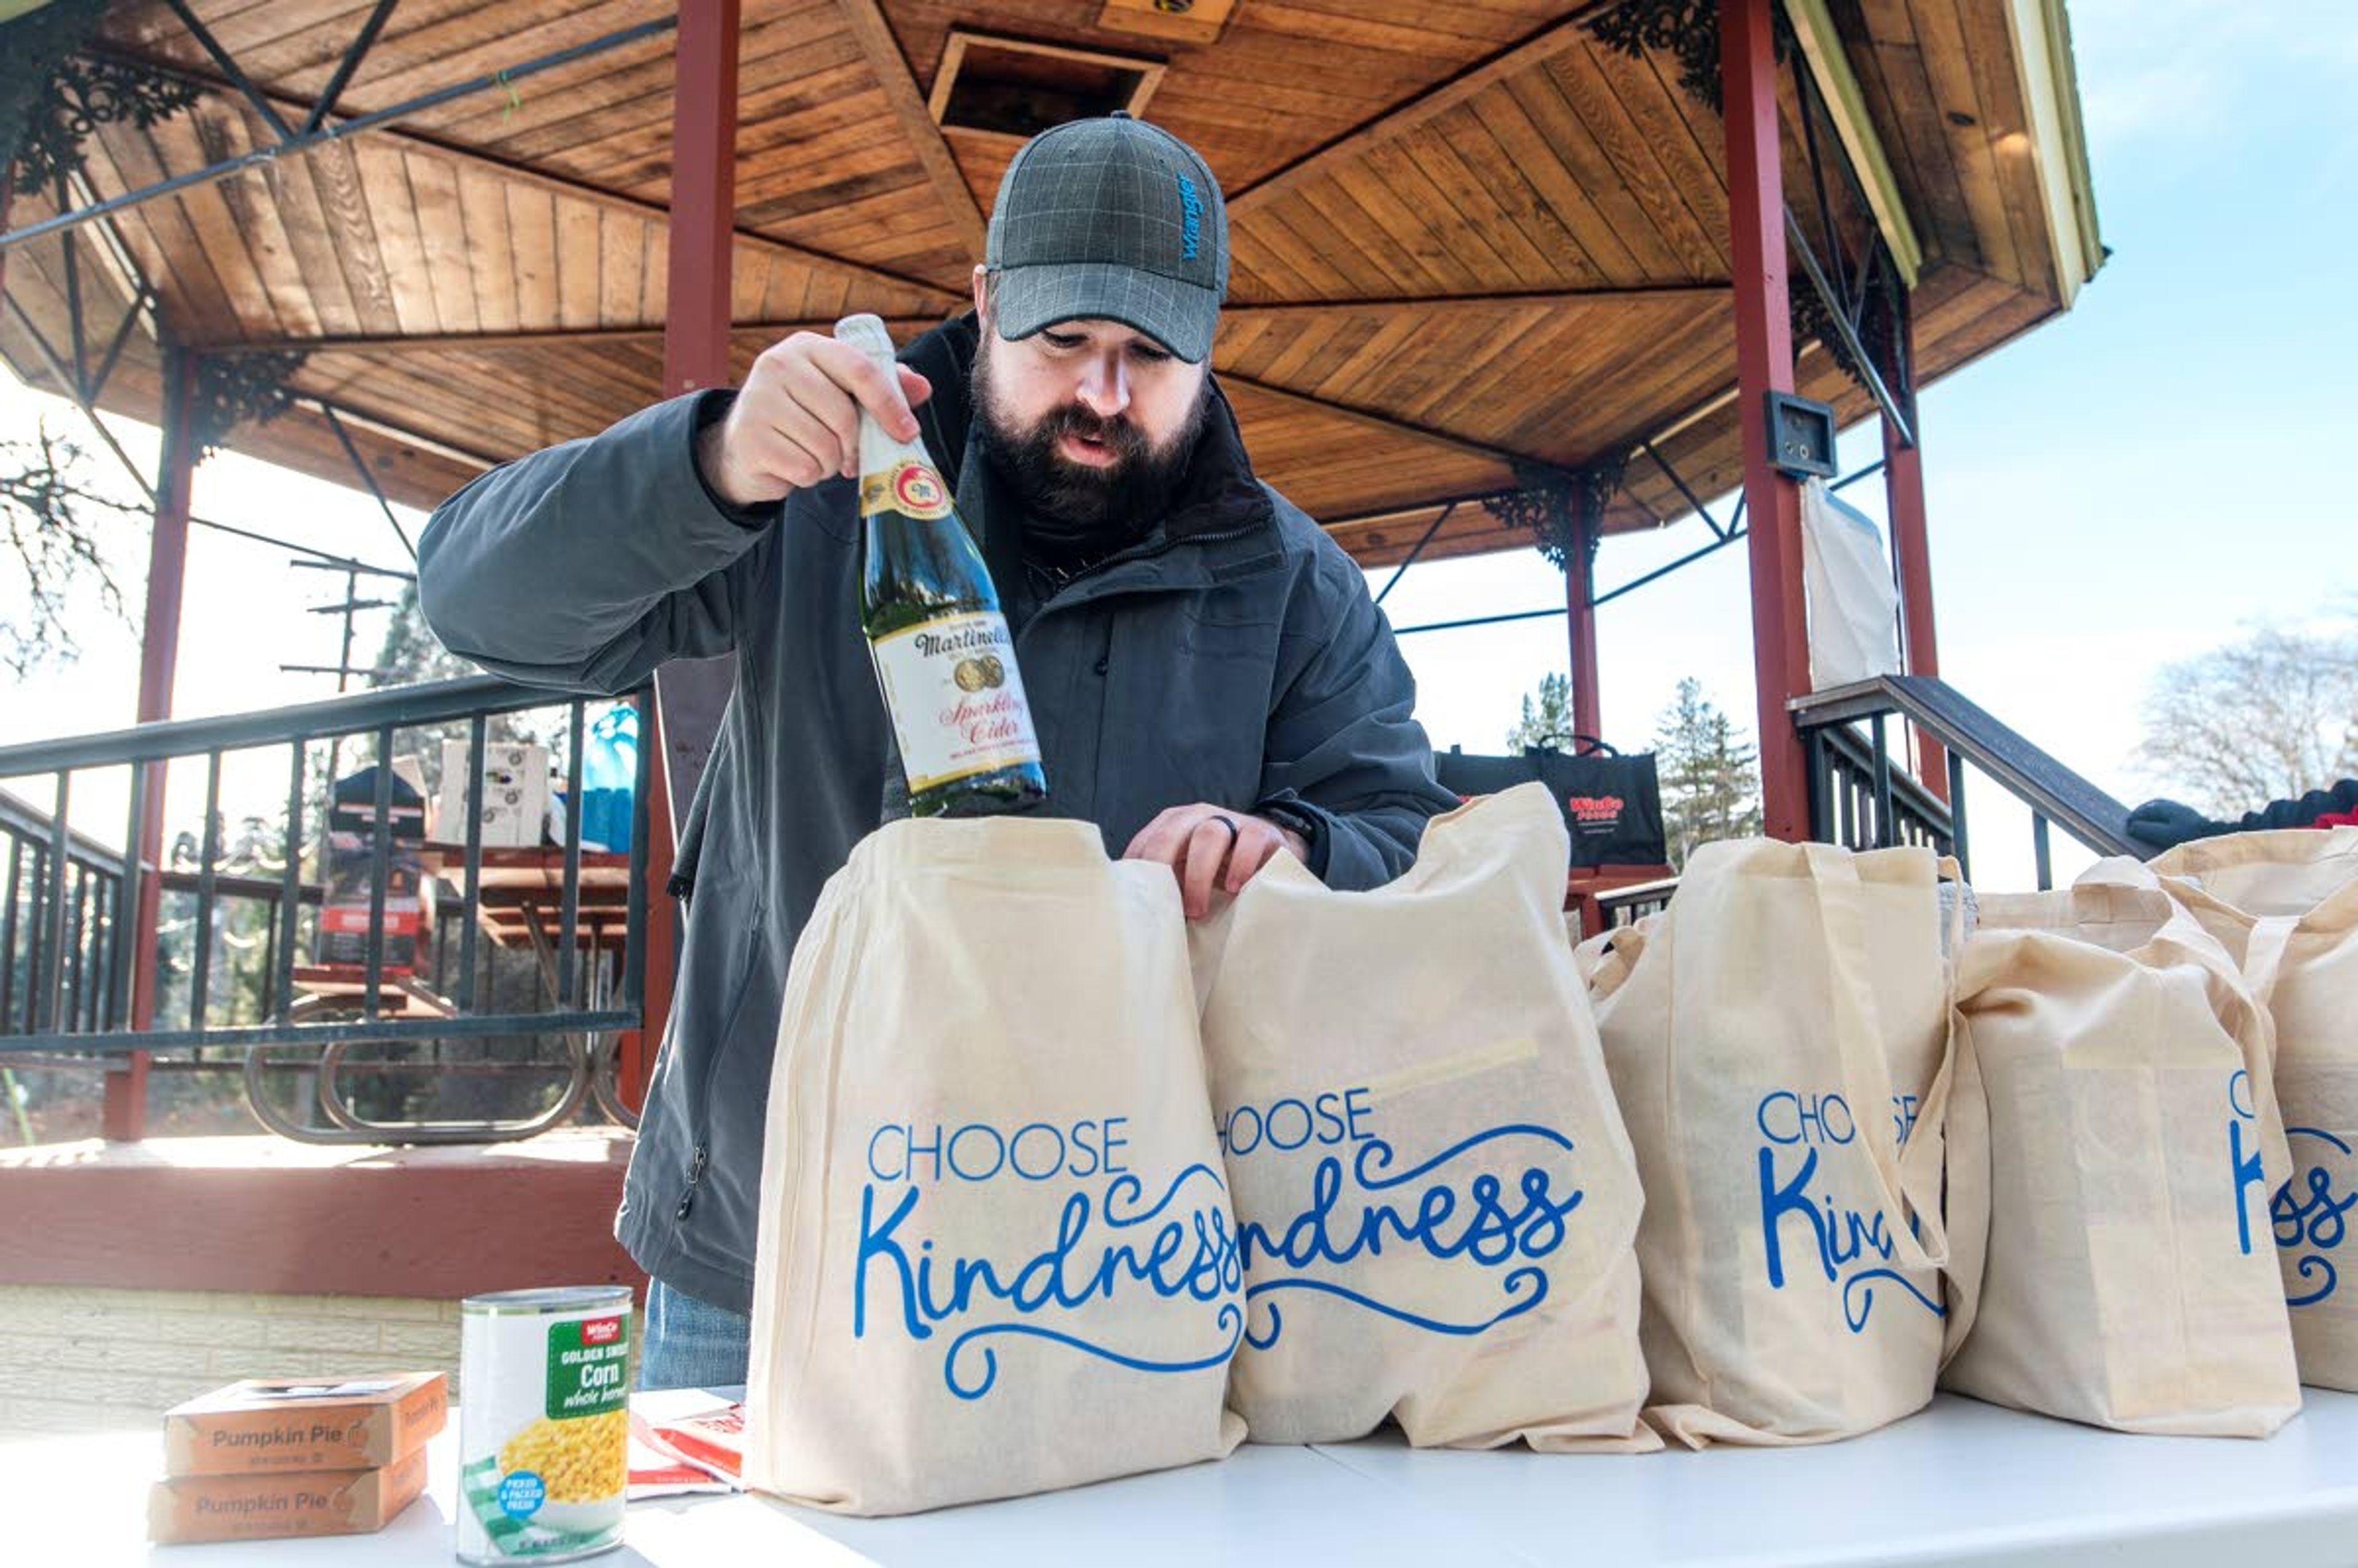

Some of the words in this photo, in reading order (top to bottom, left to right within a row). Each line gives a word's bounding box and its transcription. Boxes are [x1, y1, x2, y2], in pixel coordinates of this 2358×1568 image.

[1177, 171, 1204, 260] Wrangler
[960, 717, 1018, 743] Cider
[1215, 1088, 1374, 1158] HOOSE
[868, 1117, 1128, 1182] CHOOSE
[1238, 1157, 1583, 1271] ndness
[854, 1183, 1240, 1340] Kindness
[562, 1346, 604, 1365] GOLDEN
[582, 1363, 619, 1388] Corn
[213, 1428, 305, 1448] Pumpkin
[311, 1424, 343, 1443] Pie
[195, 1493, 289, 1514] Pumpkin
[295, 1491, 329, 1510] Pie
